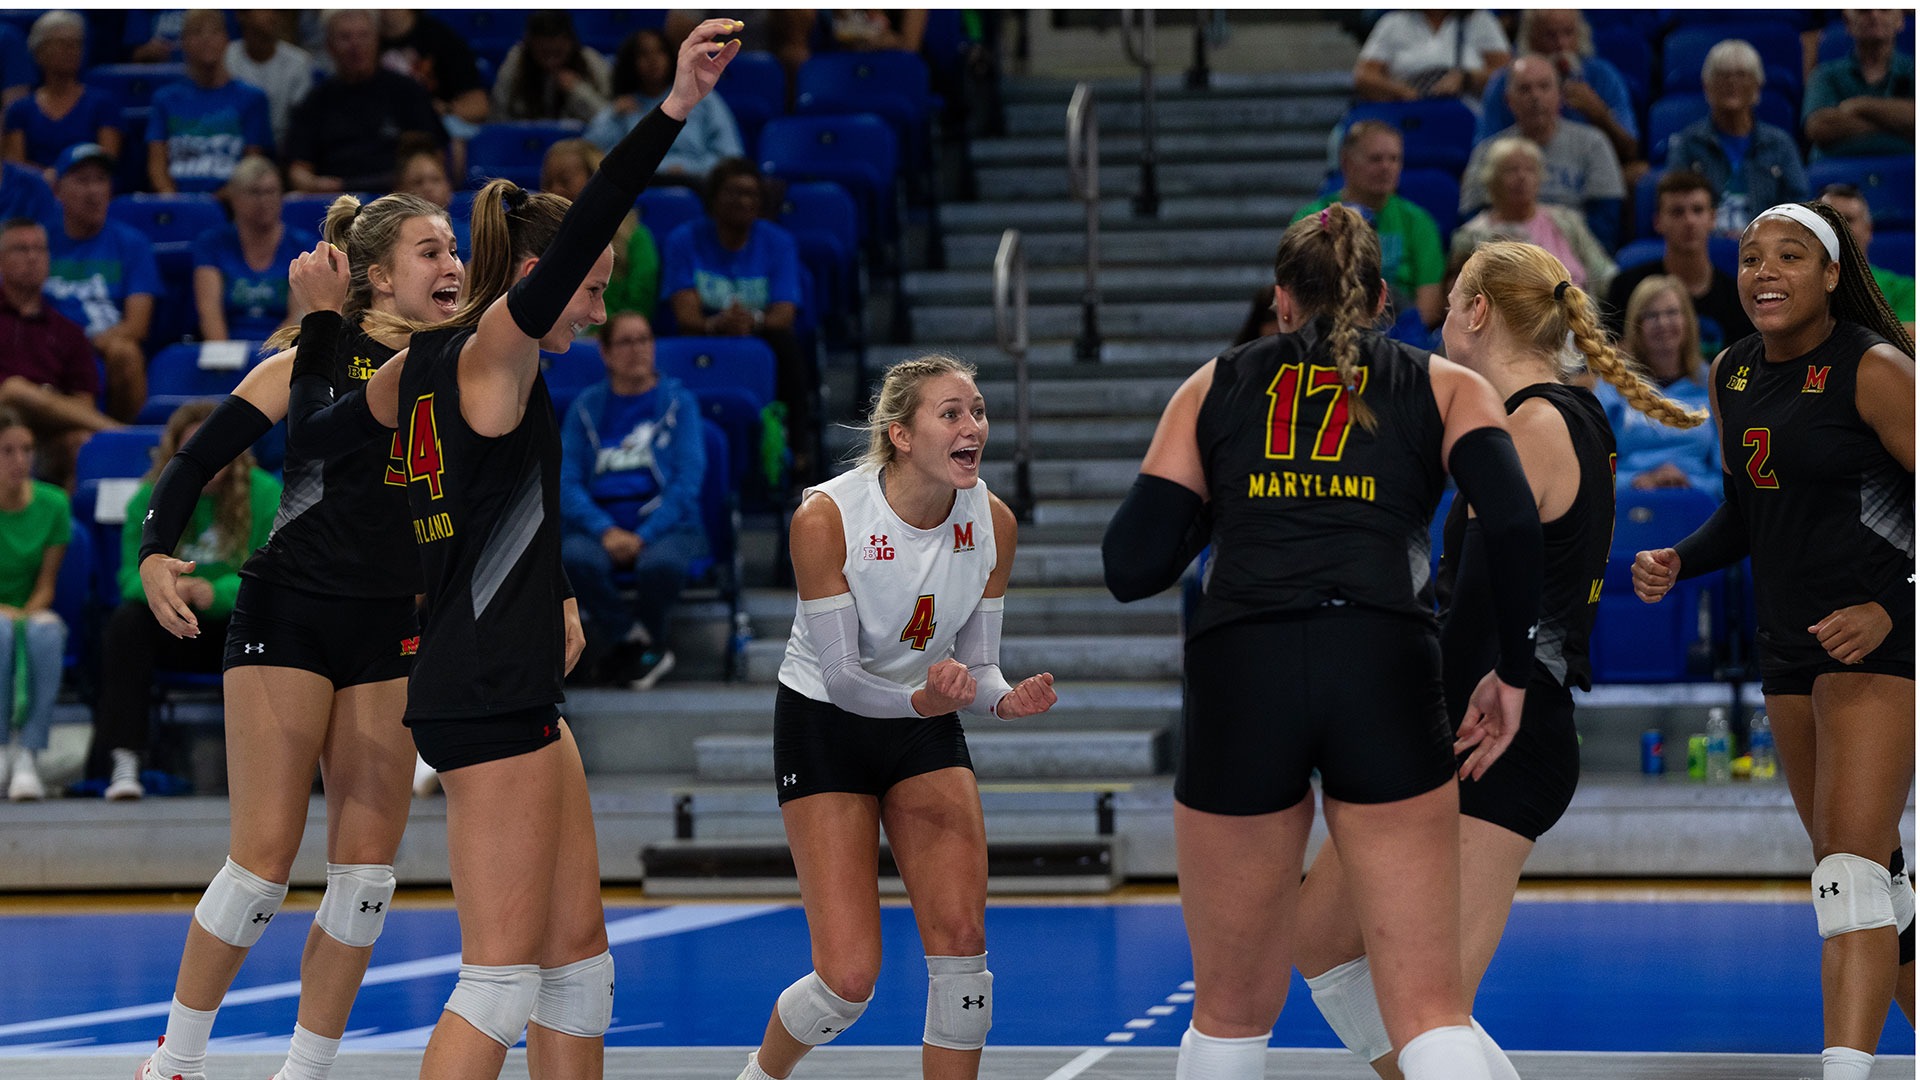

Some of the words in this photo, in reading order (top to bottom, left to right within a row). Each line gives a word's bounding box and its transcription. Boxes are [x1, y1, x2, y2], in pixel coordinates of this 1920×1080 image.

[1265, 362, 1369, 461] 17
[1248, 471, 1375, 501] MARYLAND
[1742, 427, 1780, 489] 2
[952, 521, 975, 549] M
[900, 594, 937, 651] 4
